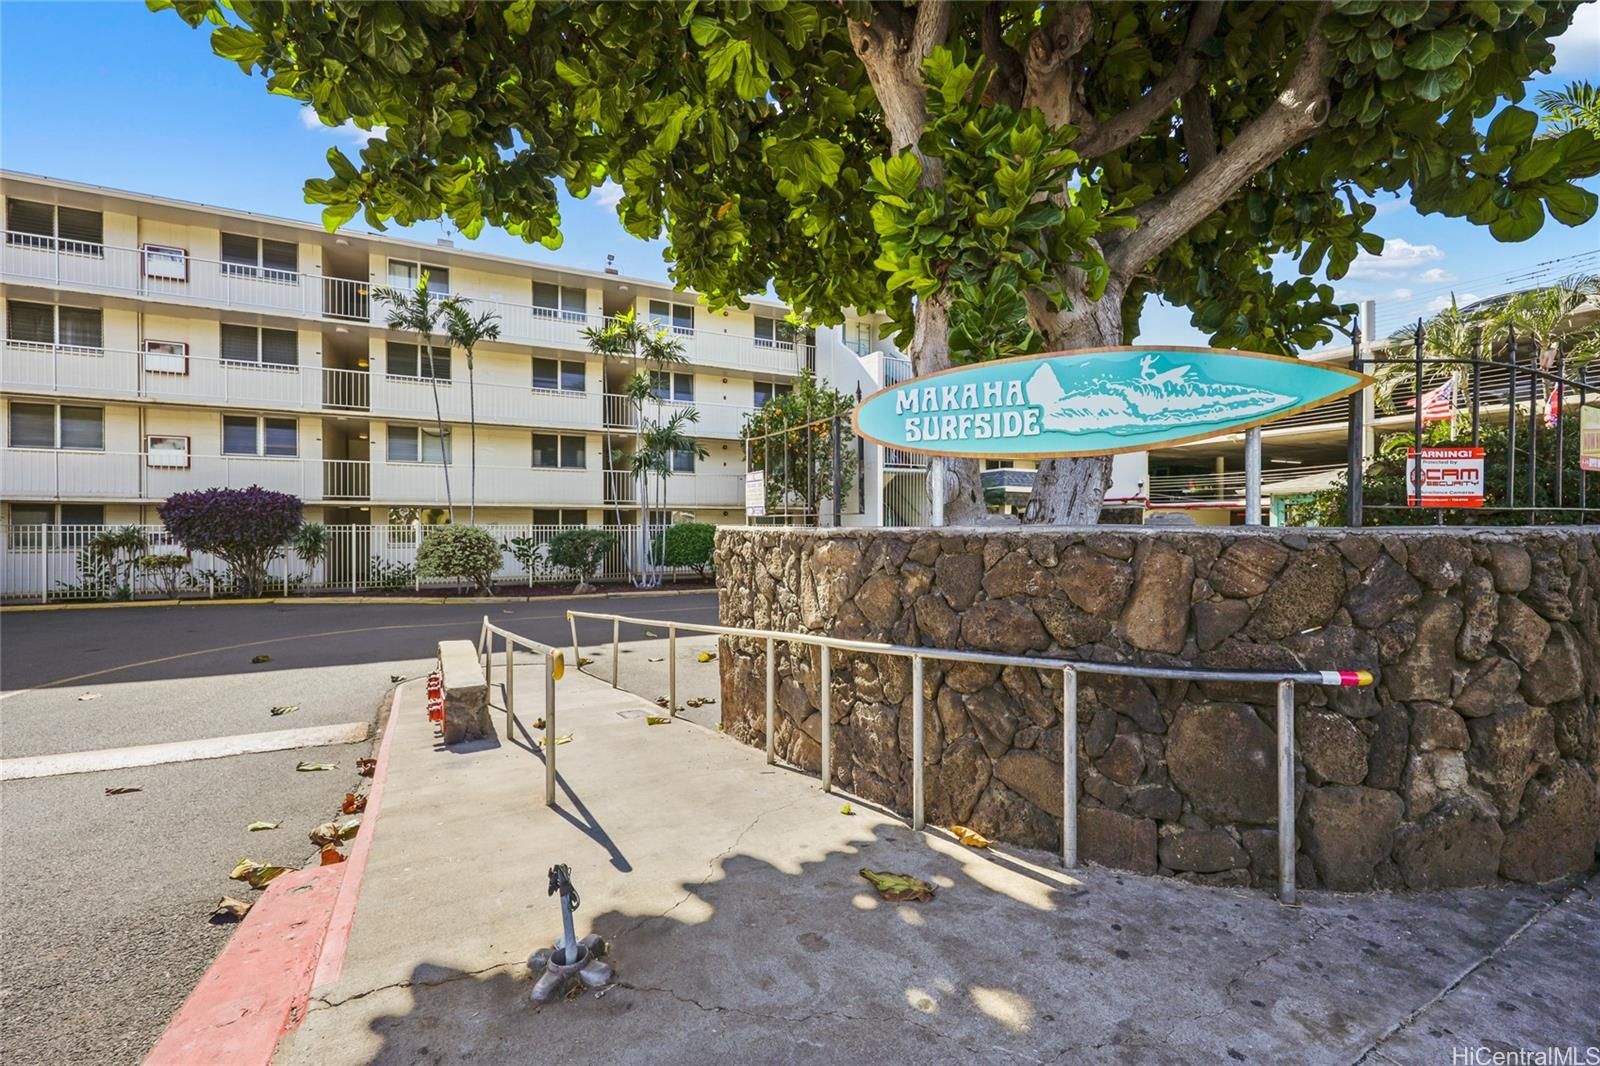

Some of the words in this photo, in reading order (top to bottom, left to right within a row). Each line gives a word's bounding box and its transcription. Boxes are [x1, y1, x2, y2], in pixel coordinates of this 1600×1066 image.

[895, 380, 1025, 415] MAKAHA
[905, 409, 1041, 442] SURFSIDE
[1416, 450, 1473, 458] ARNING!
